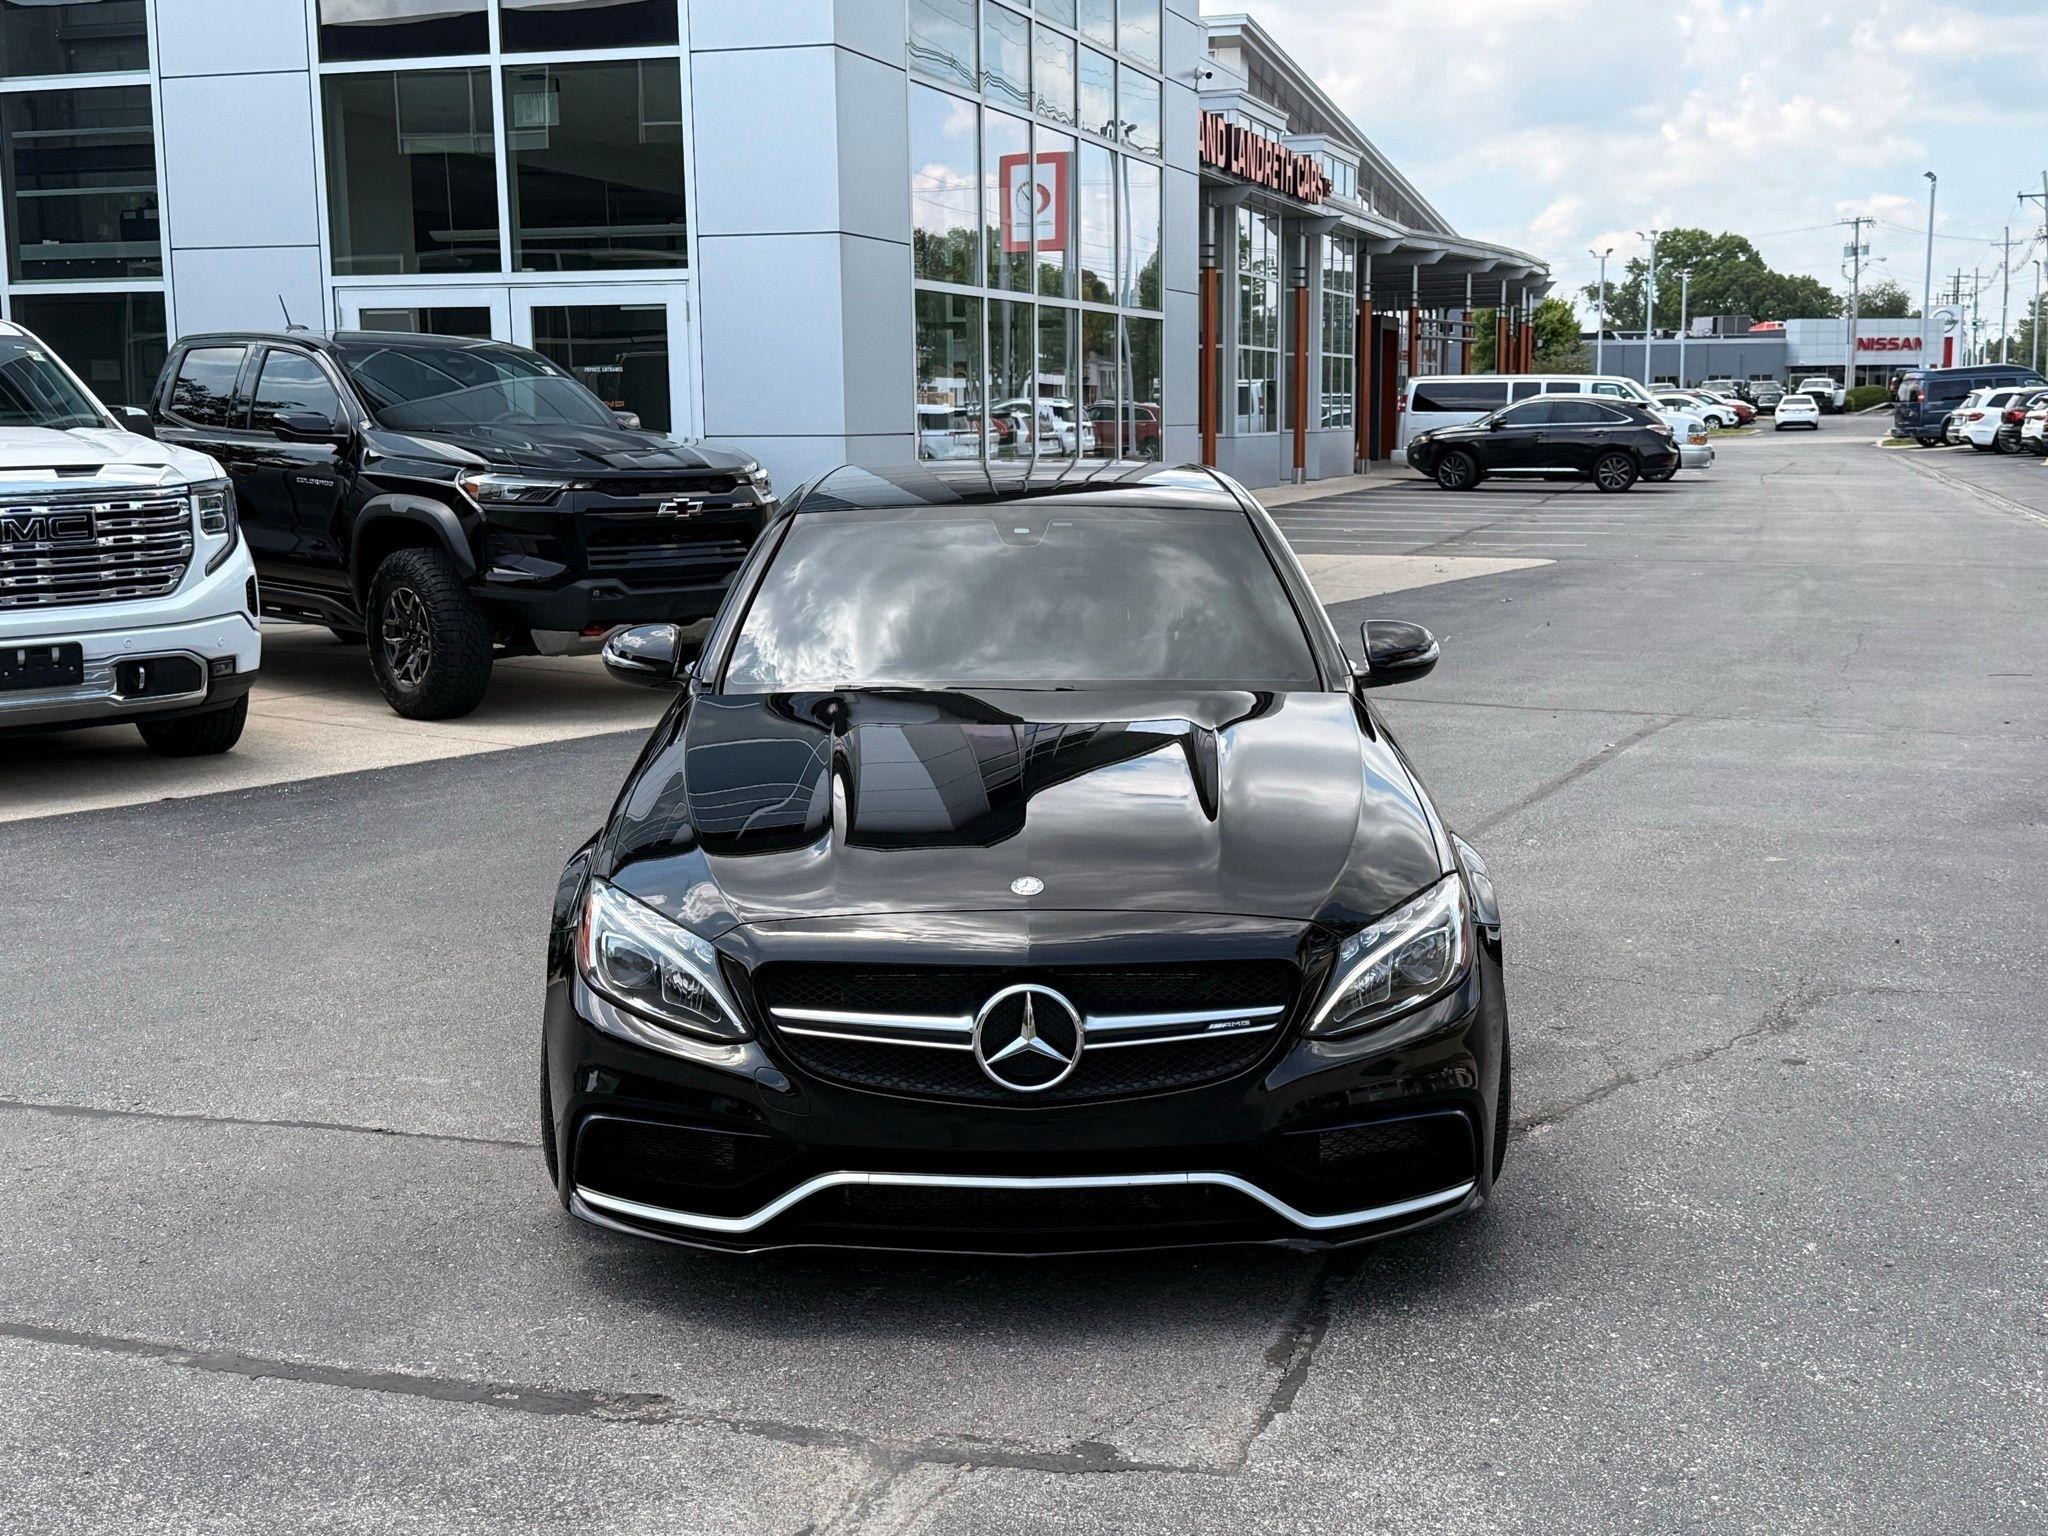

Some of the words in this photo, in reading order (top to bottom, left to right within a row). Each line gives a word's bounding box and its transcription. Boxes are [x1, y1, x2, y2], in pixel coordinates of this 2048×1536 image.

[1231, 123, 1294, 195] LANDRETH
[1297, 154, 1324, 205] CARS
[296, 477, 334, 487] COLORADO
[0, 515, 89, 542] MC
[1220, 1019, 1251, 1029] AMG
